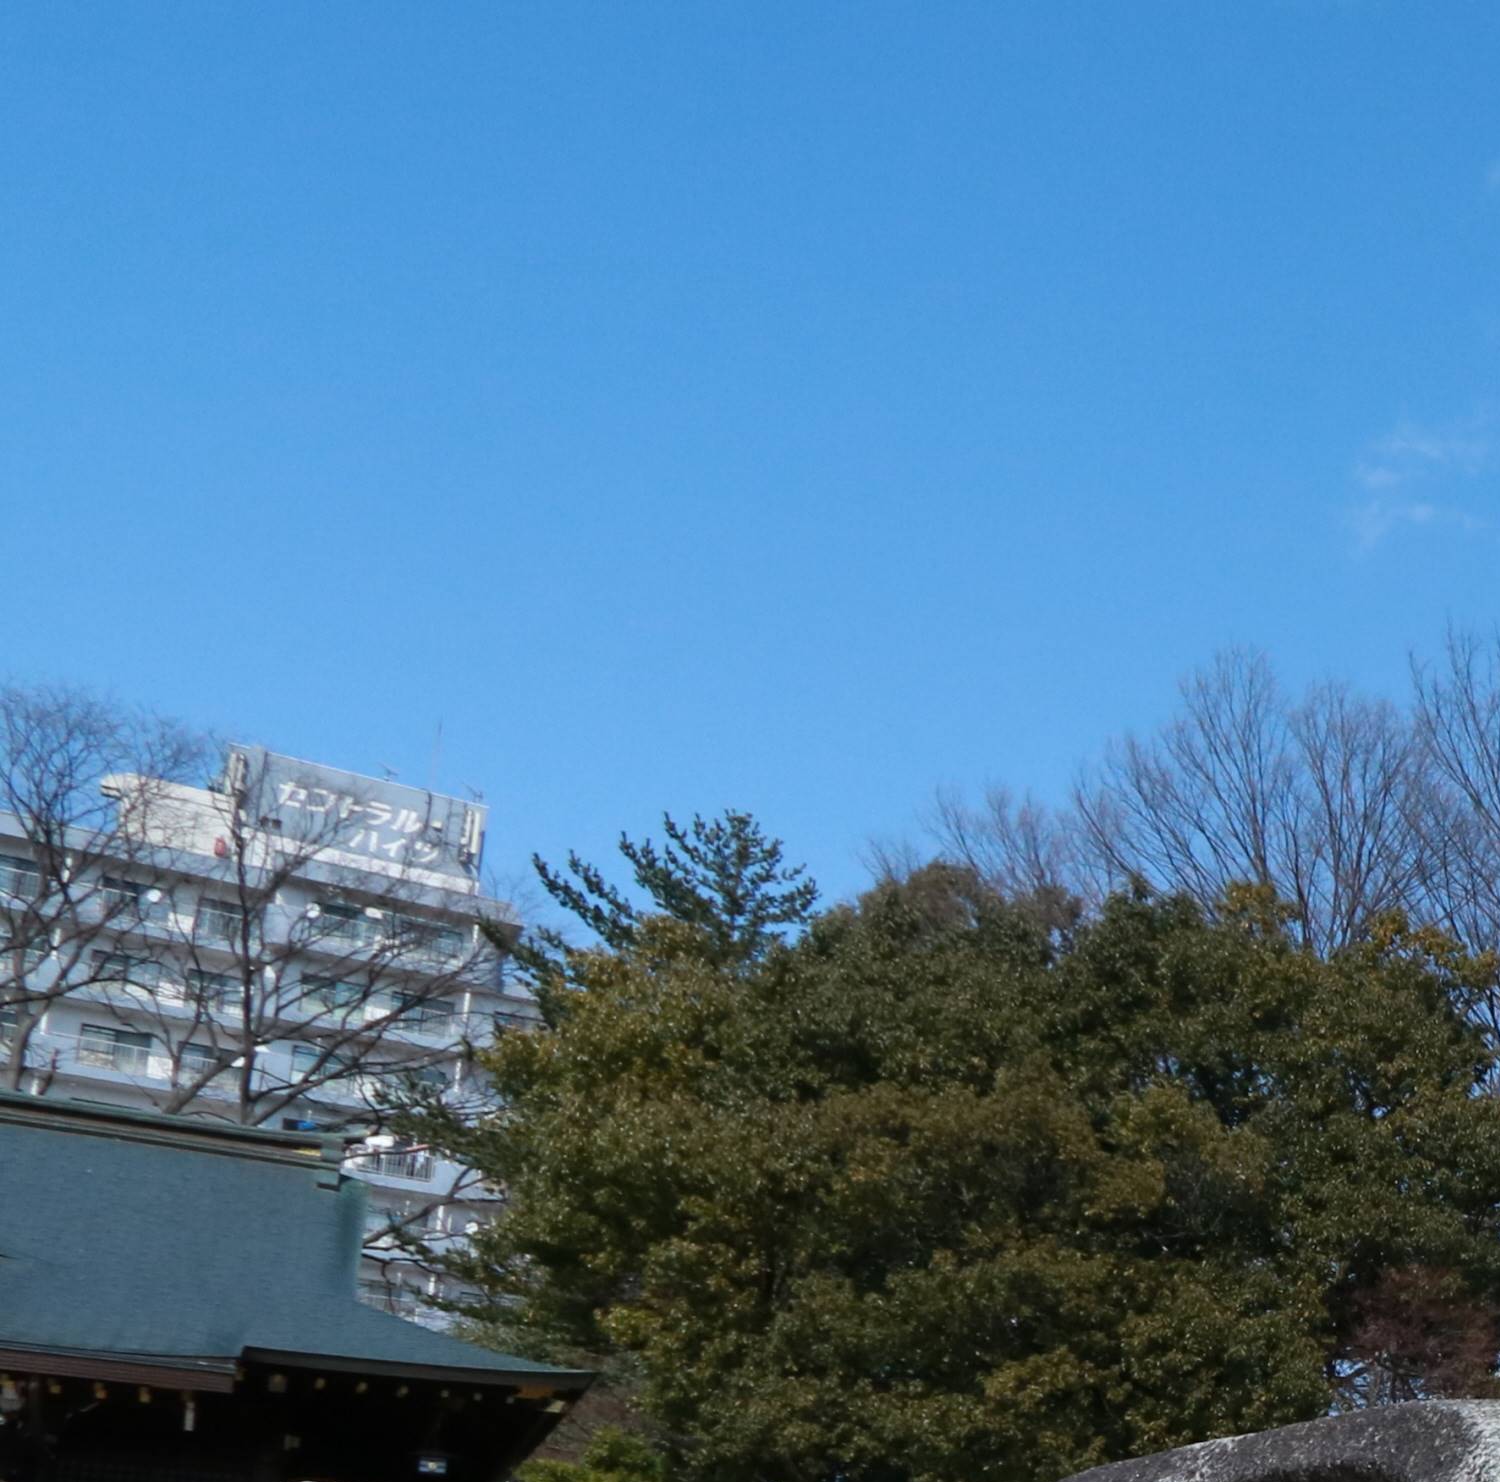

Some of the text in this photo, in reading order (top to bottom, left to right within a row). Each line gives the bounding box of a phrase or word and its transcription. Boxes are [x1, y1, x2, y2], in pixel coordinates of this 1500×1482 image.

[279, 782, 424, 833] セントラル
[350, 831, 440, 864] ハイツ
